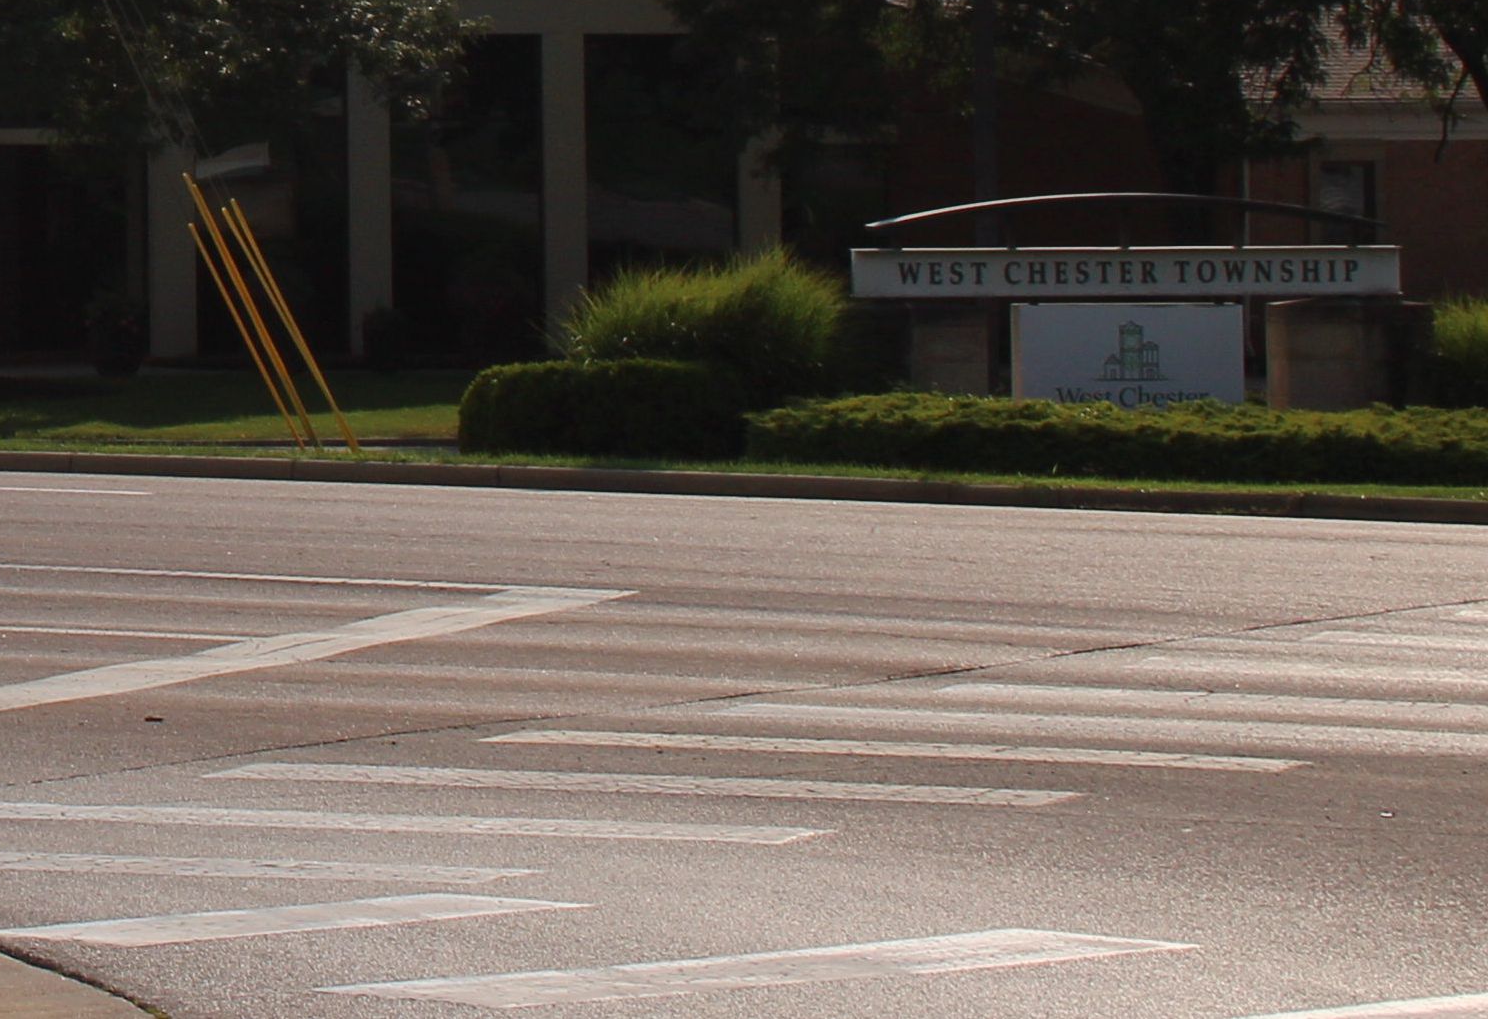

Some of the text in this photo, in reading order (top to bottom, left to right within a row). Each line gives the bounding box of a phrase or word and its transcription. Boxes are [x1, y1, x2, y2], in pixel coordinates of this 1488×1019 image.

[899, 260, 1359, 285] WEST CHESTER TOWNSHIP
[1056, 387, 1112, 404] West
